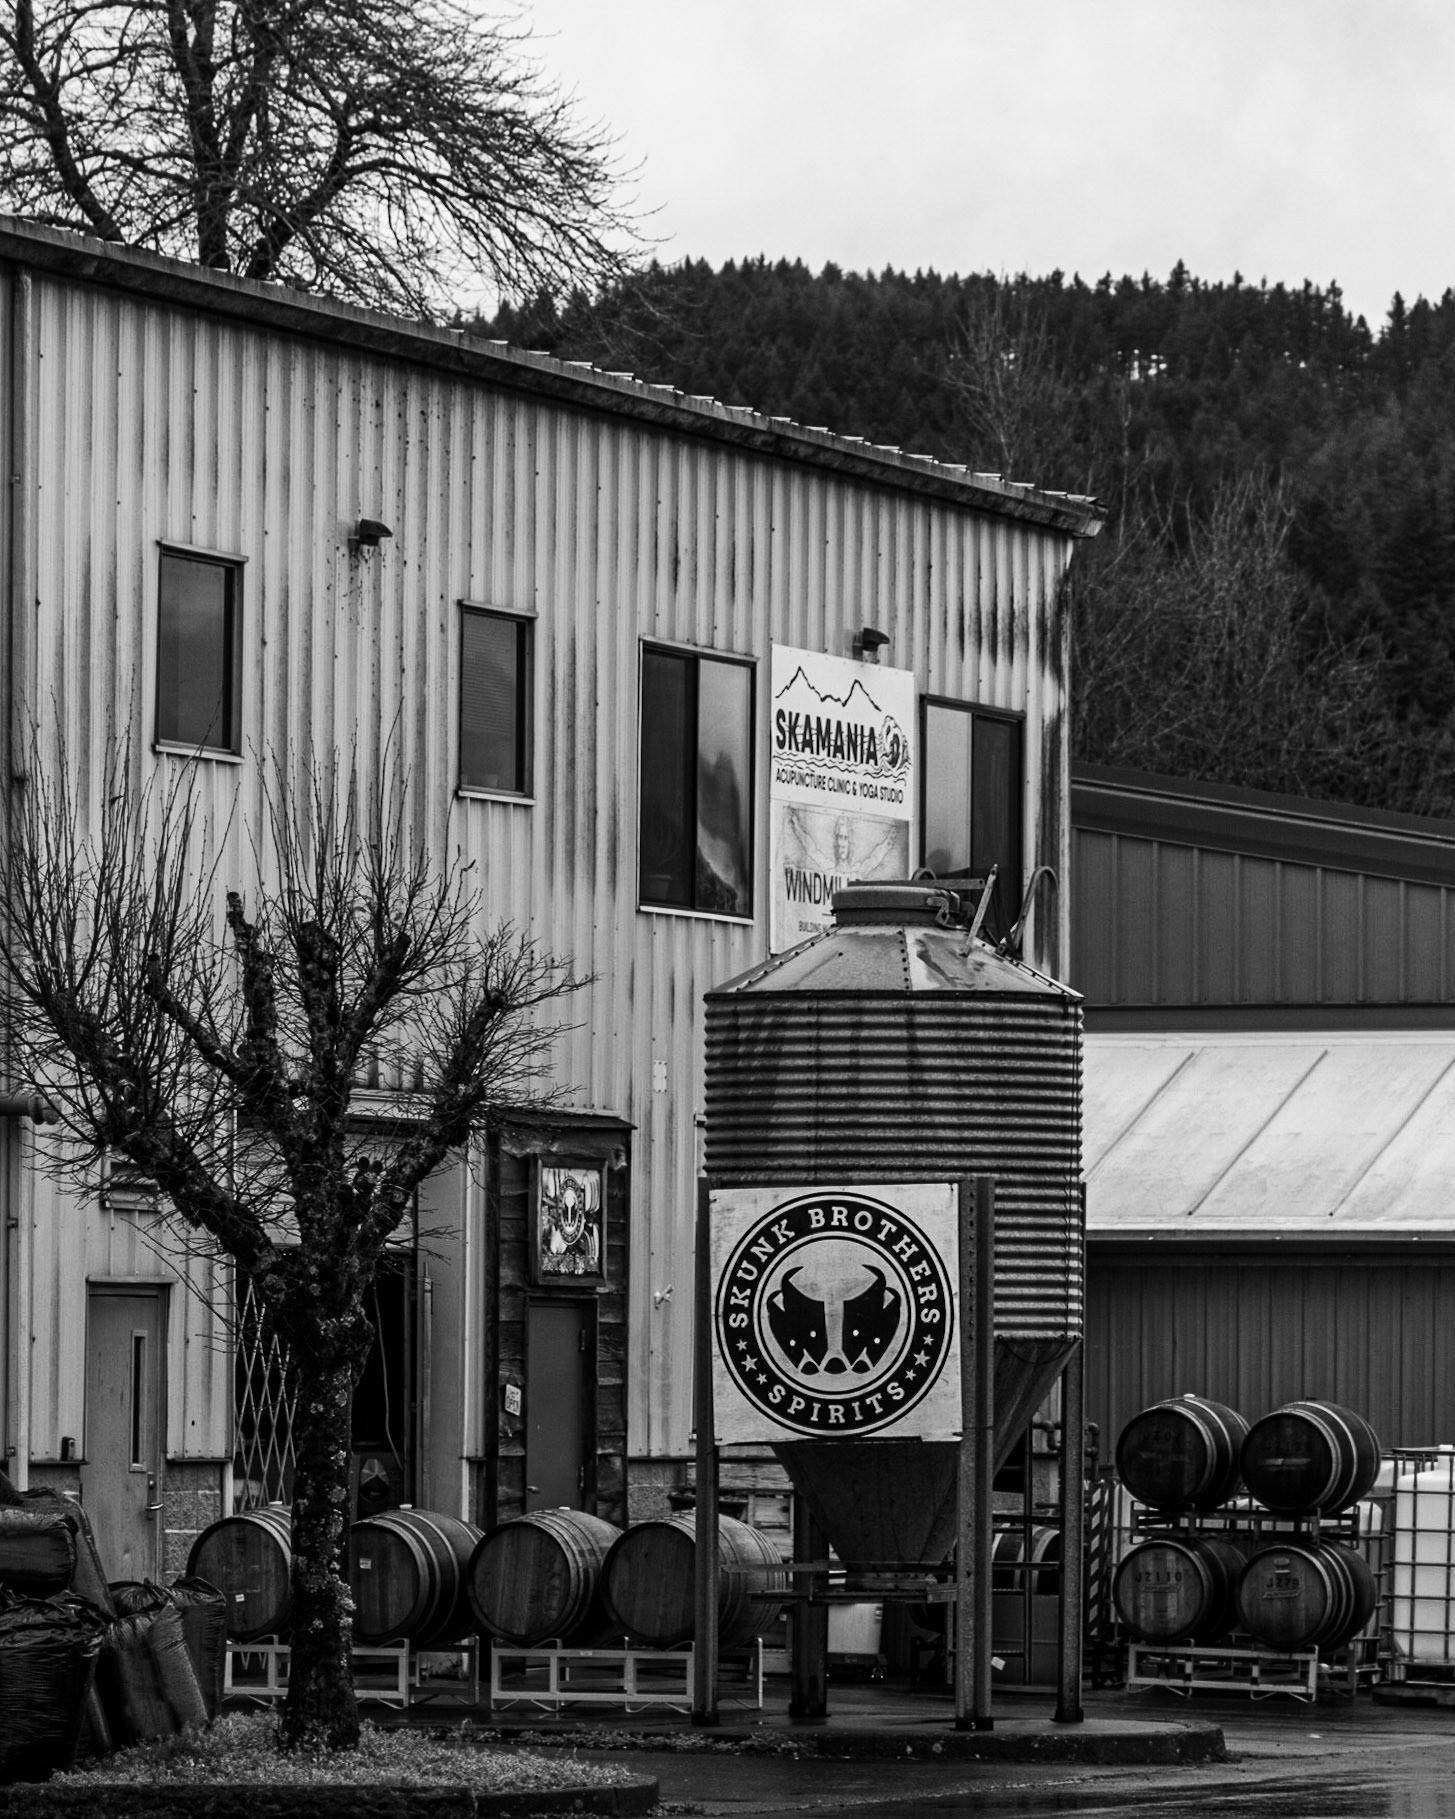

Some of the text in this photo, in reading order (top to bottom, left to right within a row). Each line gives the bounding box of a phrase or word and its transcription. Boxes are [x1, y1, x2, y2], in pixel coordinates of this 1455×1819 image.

[776, 708, 878, 766] SKAMANIA
[775, 768, 904, 804] ACUPUNCTURE CLINIC & YOGA STUDIO
[729, 1206, 940, 1328] SKUNK BROTHERS
[768, 1382, 905, 1424] SPIRITS
